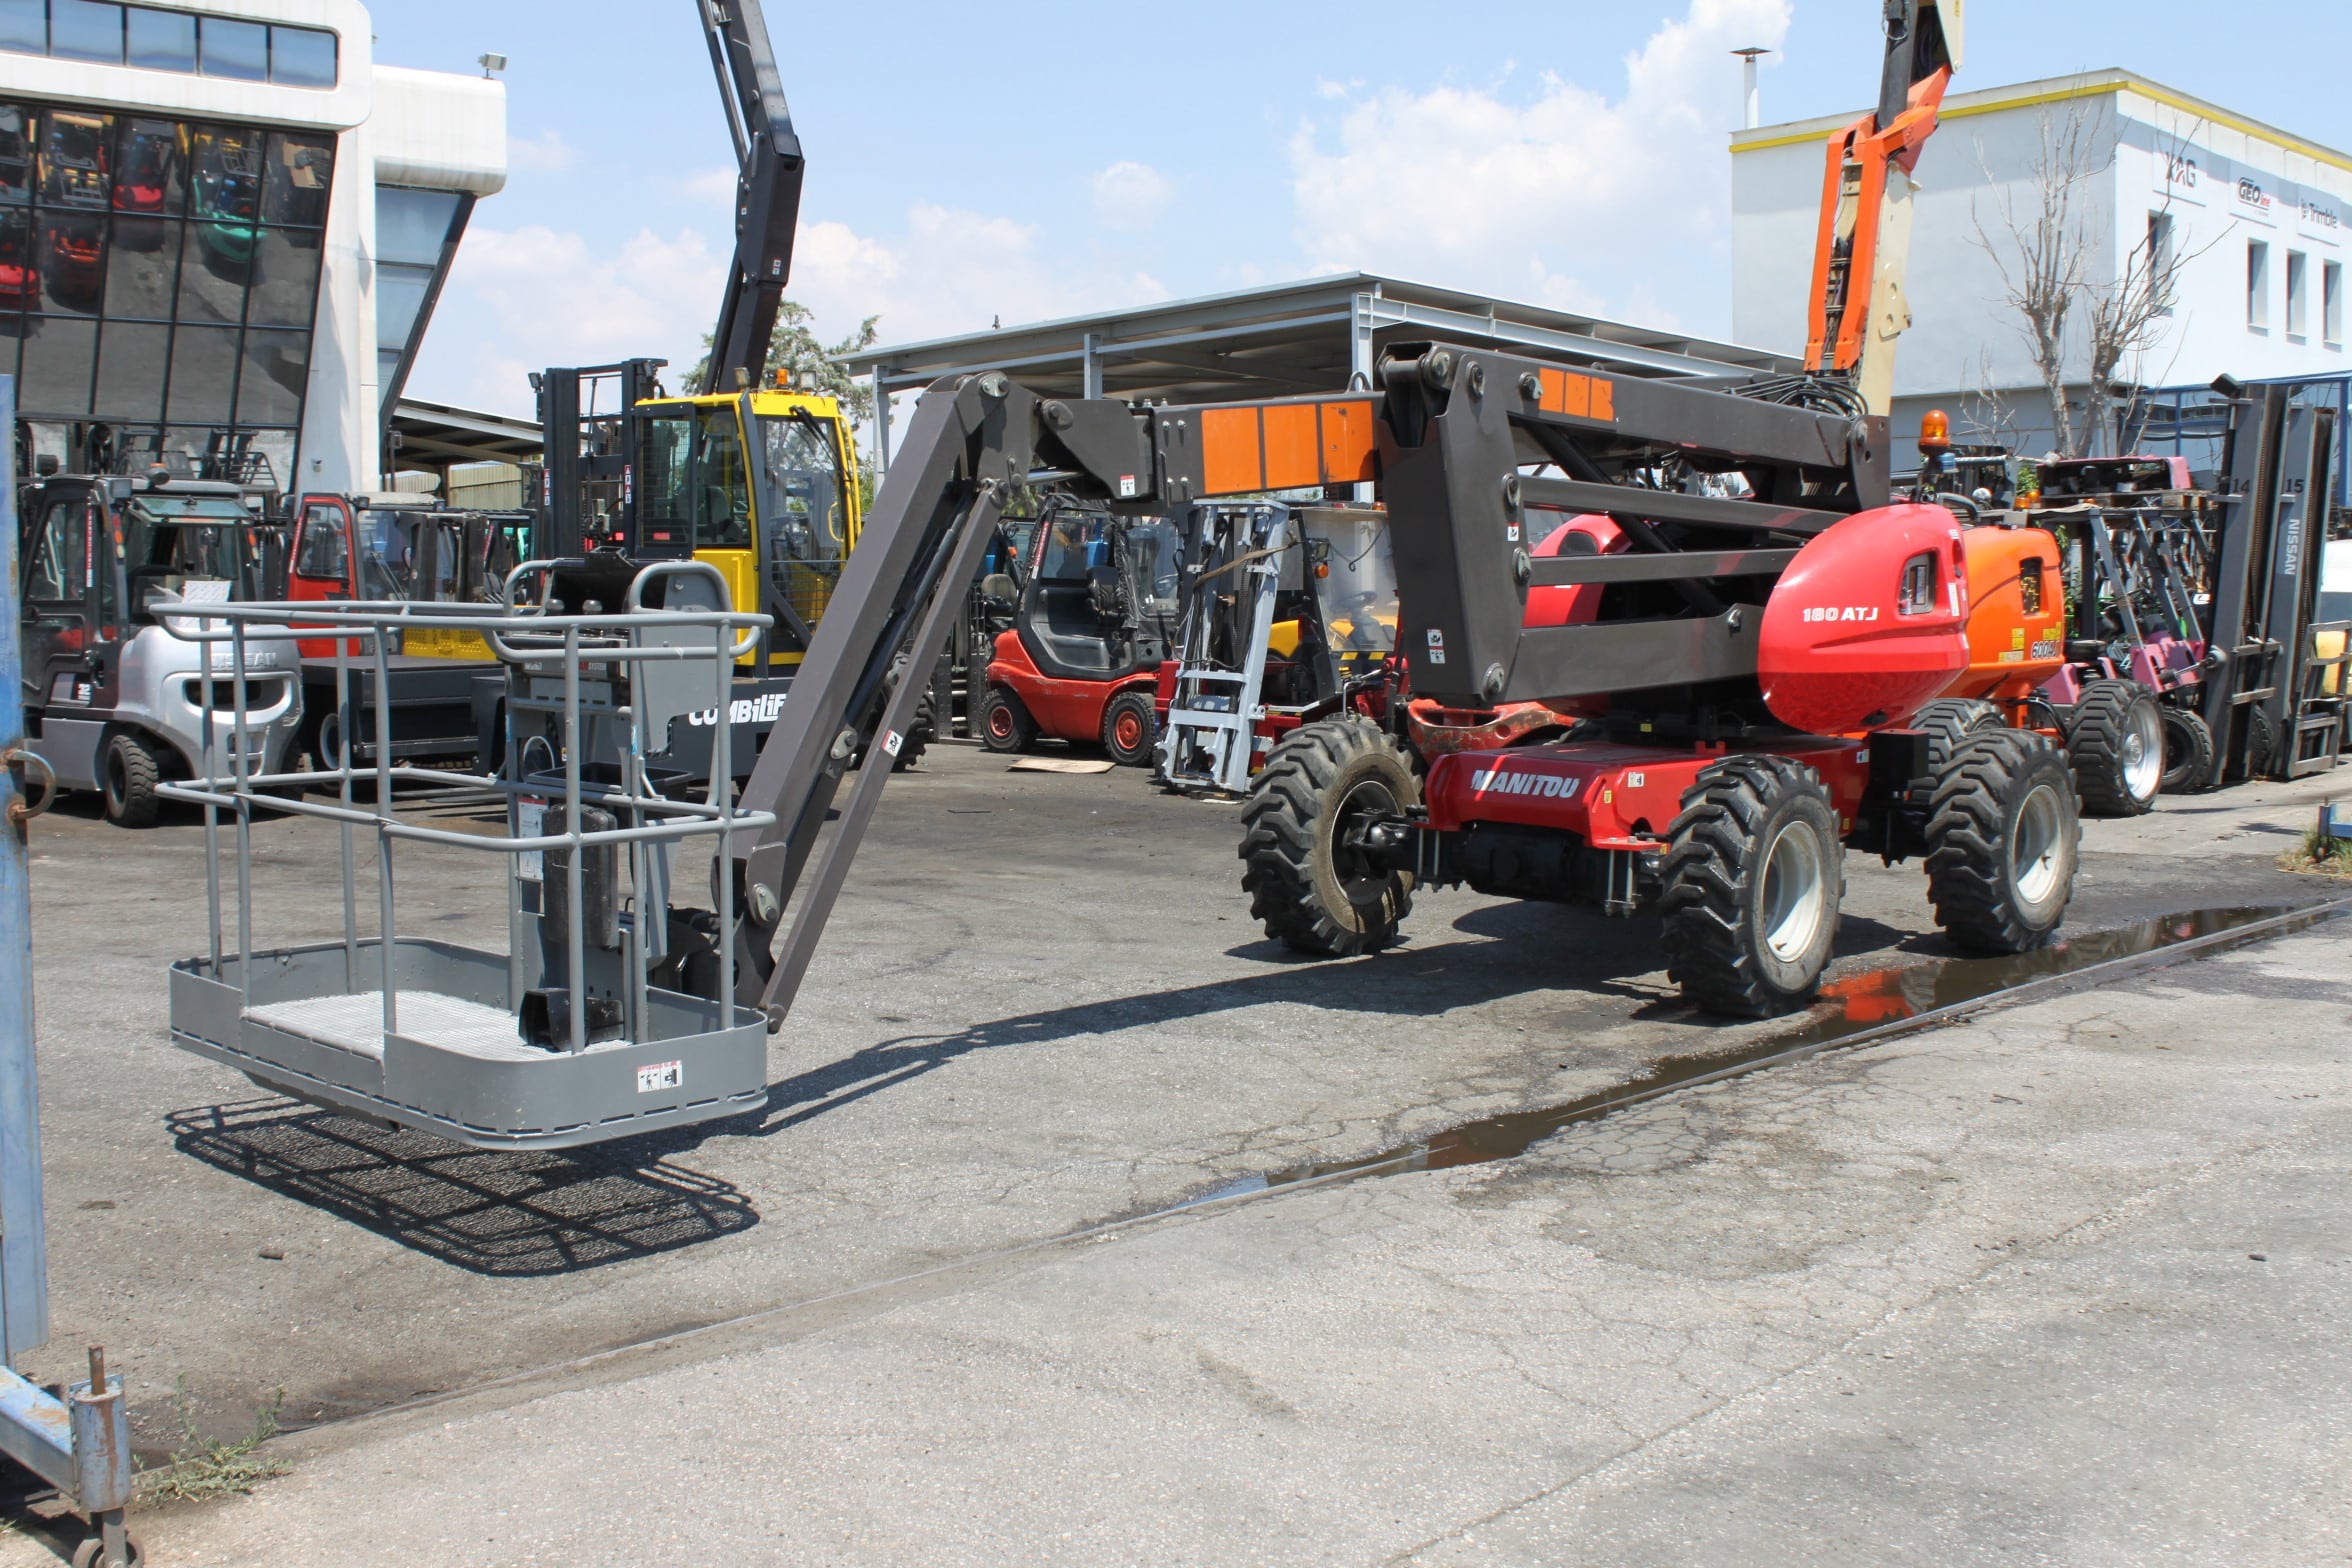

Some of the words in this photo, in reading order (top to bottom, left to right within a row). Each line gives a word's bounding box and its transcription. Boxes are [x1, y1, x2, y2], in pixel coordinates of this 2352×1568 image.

[2232, 478, 2250, 494] 14
[2285, 478, 2305, 493] 15
[2284, 518, 2300, 575] NISSAN
[1803, 607, 1838, 622] 180
[1841, 607, 1878, 621] ATJ
[1471, 769, 1580, 798] MANITOU
